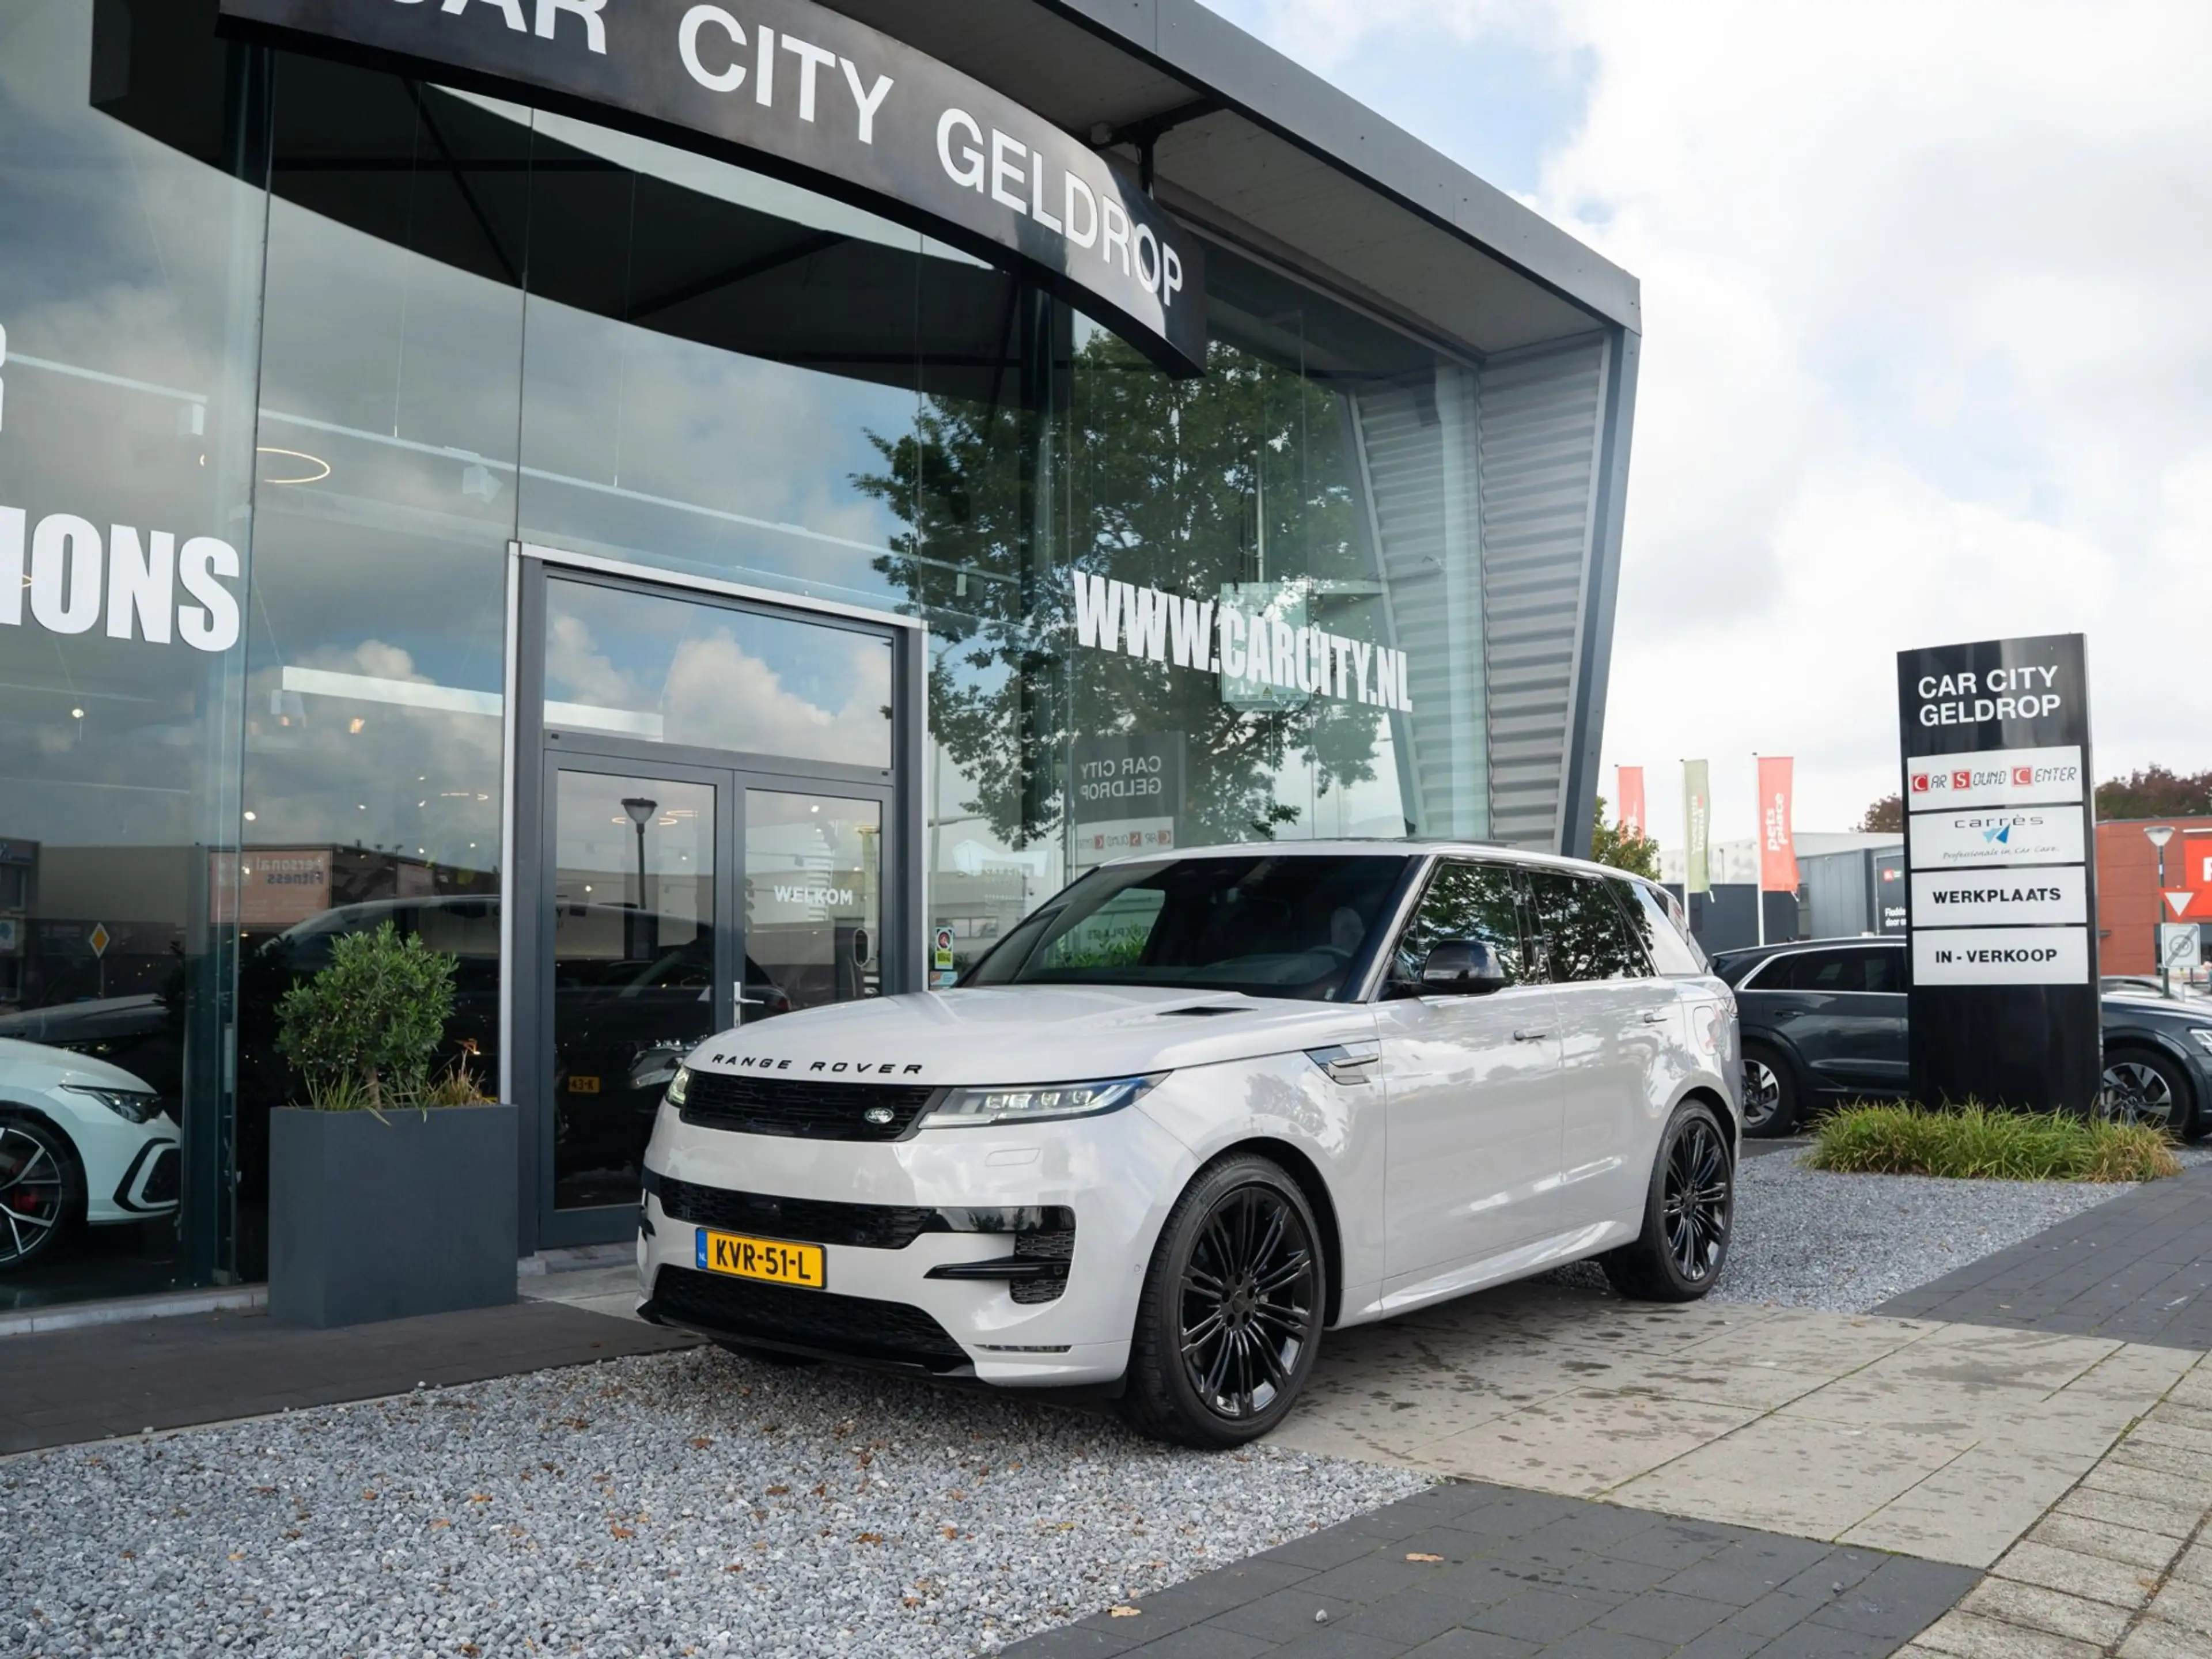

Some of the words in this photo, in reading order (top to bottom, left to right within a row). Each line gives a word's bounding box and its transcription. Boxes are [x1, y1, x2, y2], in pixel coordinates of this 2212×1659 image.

[679, 5, 895, 145] CITY
[936, 108, 1183, 307] GELDROP
[1073, 570, 1412, 713] WWW.CARCITY.NL
[1918, 672, 1977, 699] CAR
[1986, 665, 2058, 692] CITY
[1919, 694, 2061, 727] GELDROP
[1913, 774, 1947, 791] CAR
[1955, 770, 2007, 789] SOUND
[2016, 766, 2077, 785] CENTER
[1955, 814, 2044, 828] carrès
[774, 885, 853, 906] WELKOM
[1933, 888, 2062, 904] WERKPLAATS
[1935, 950, 1952, 963] IN
[1966, 949, 2058, 963] VERKOOP
[711, 1054, 792, 1069] RANGE
[809, 1062, 923, 1075] ROVER
[716, 1238, 811, 1280] KVR-51-L
